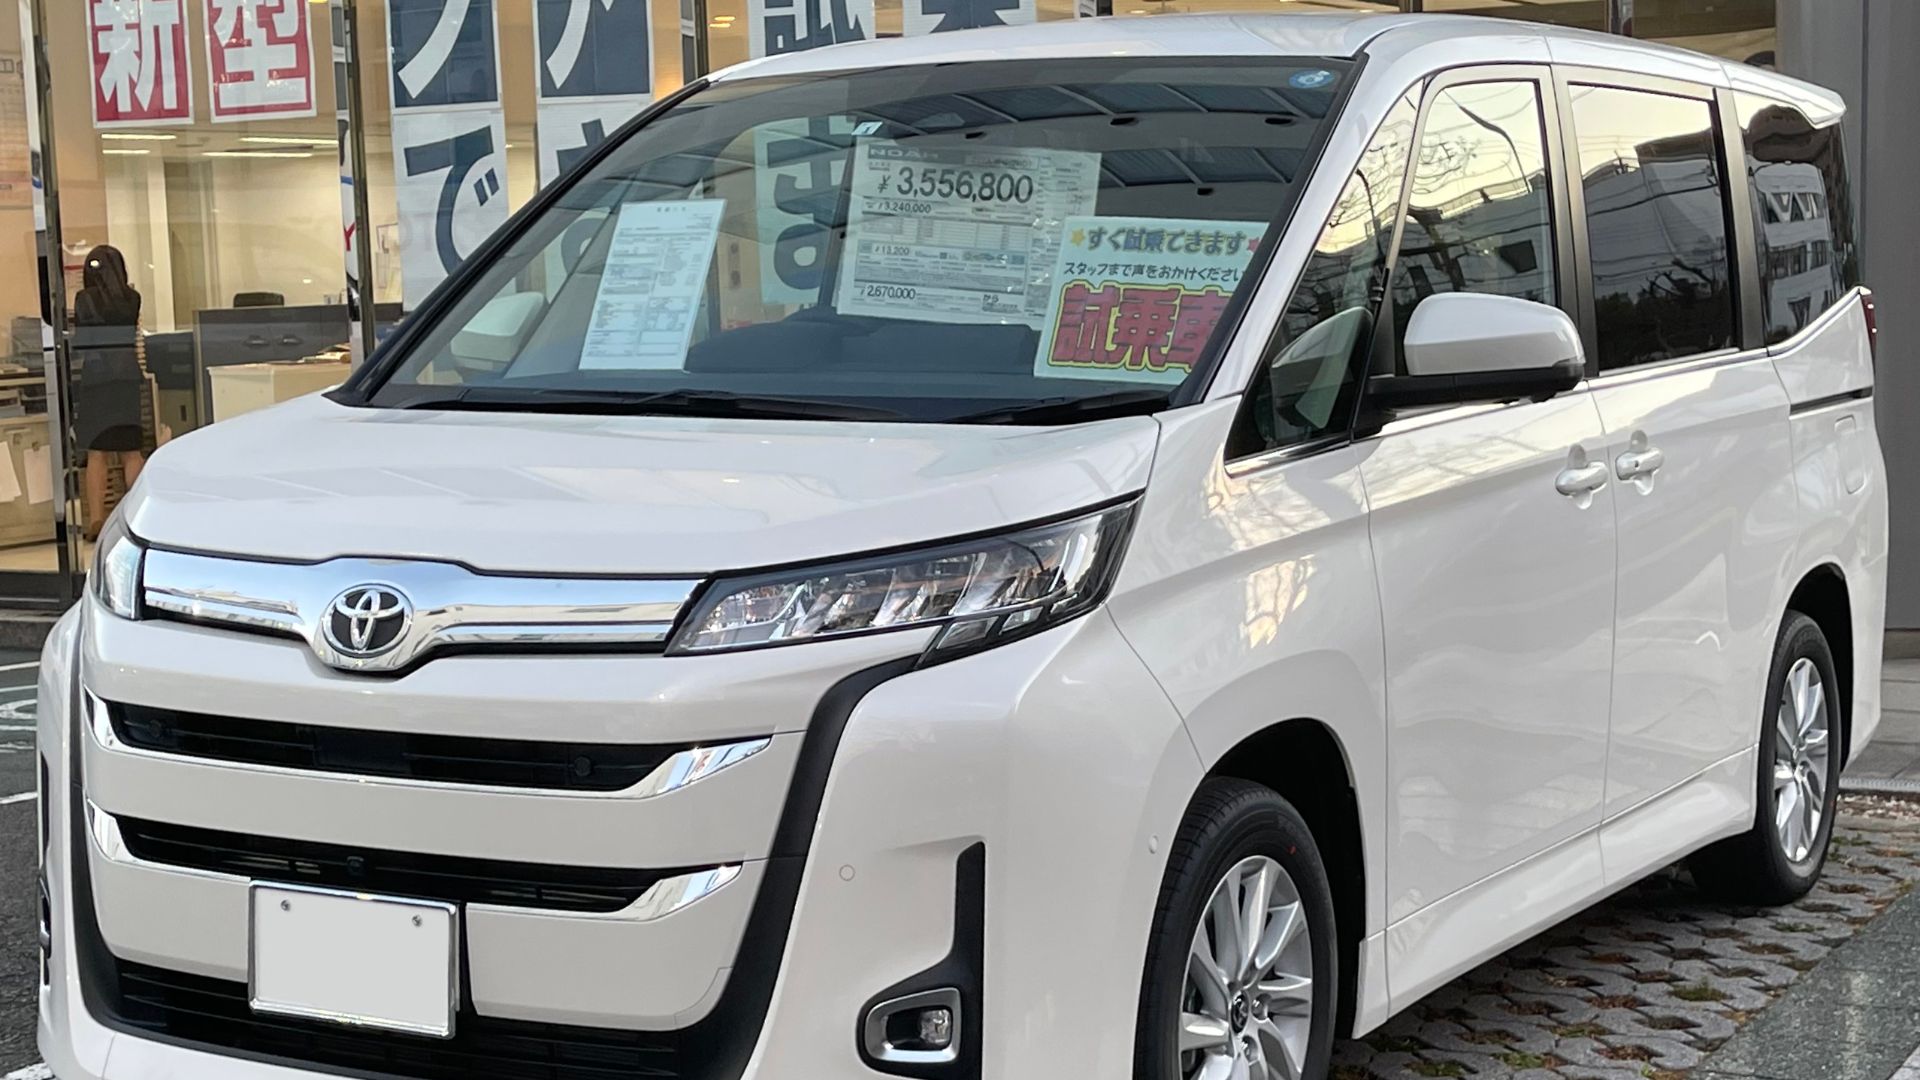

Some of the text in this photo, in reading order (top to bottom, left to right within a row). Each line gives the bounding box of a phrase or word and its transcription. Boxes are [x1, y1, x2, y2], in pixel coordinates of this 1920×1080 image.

[1087, 227, 1247, 255] すぐ試乗できます
